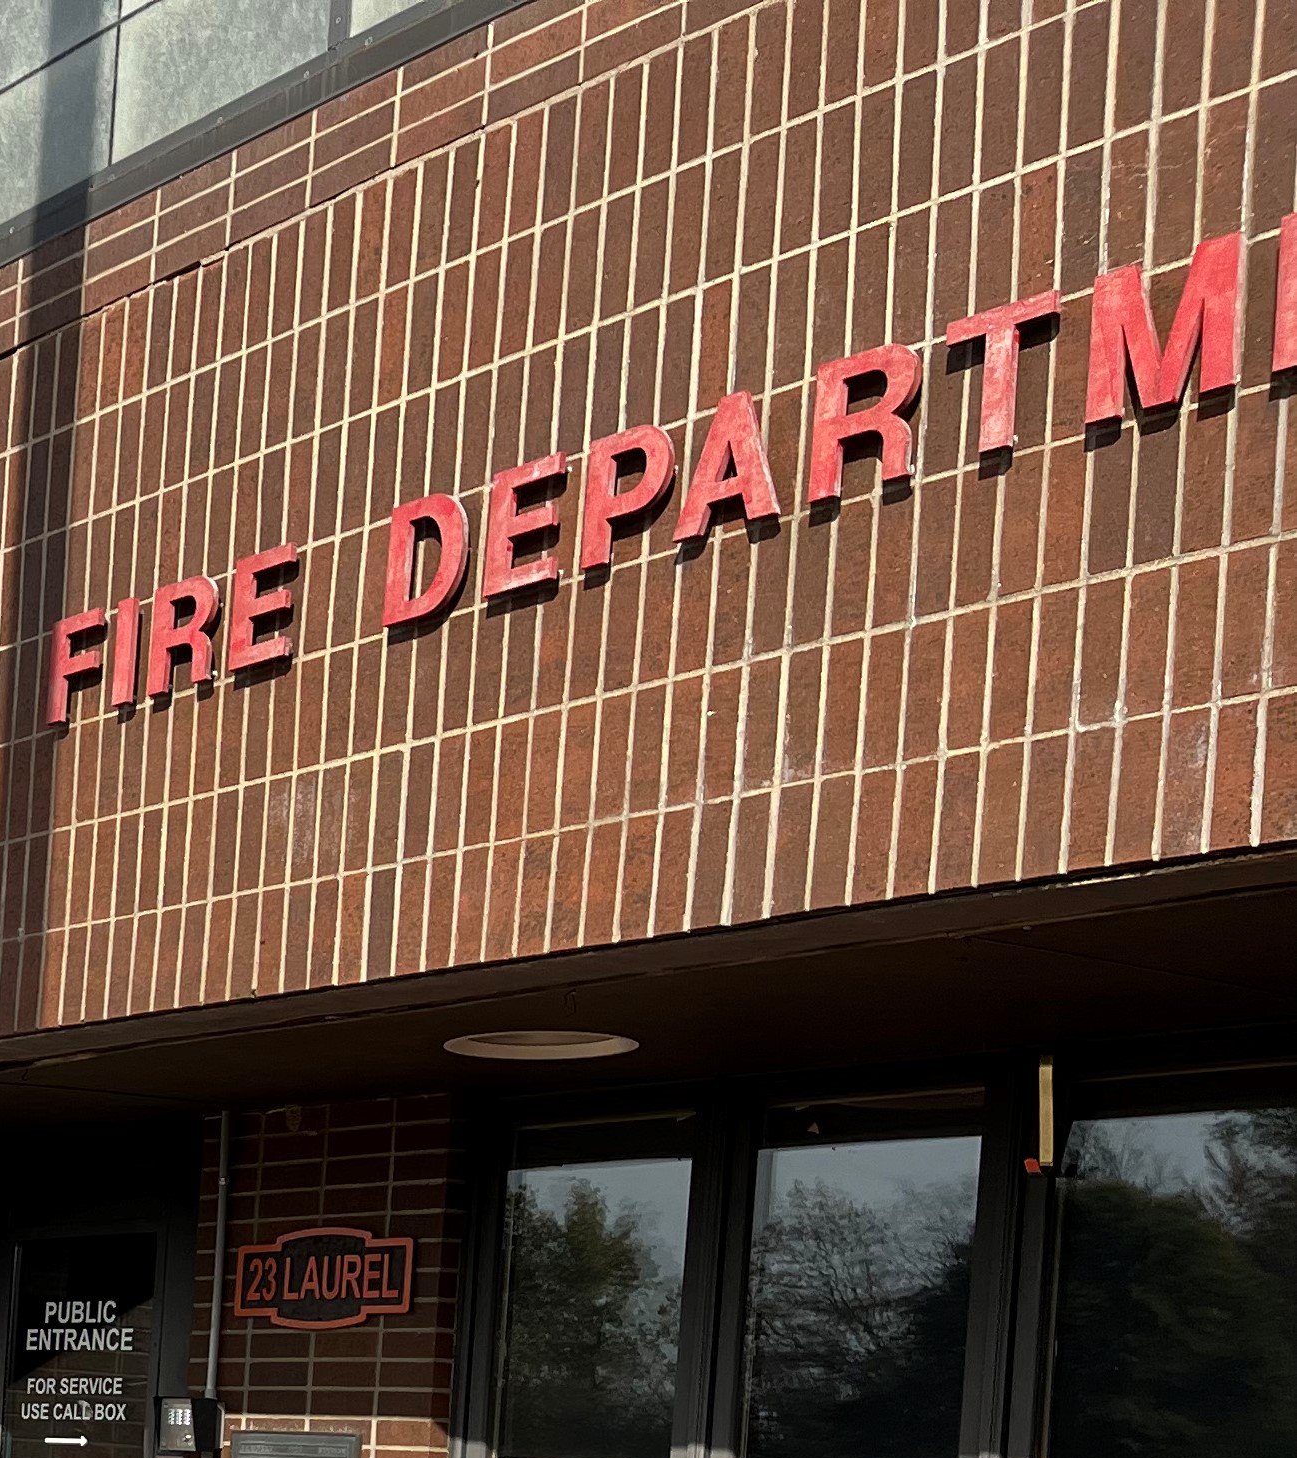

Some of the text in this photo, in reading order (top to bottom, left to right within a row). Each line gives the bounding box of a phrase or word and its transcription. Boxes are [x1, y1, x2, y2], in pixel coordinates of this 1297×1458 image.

[46, 541, 299, 727] FIRE
[382, 212, 1297, 626] DEPARTM
[246, 1253, 400, 1301] 23 LAUREL
[44, 1300, 117, 1324] PUBLIC
[25, 1327, 134, 1351] ENTRANCE
[27, 1377, 123, 1395] FOR SERVICE
[21, 1403, 127, 1421] USE CALL BOX
